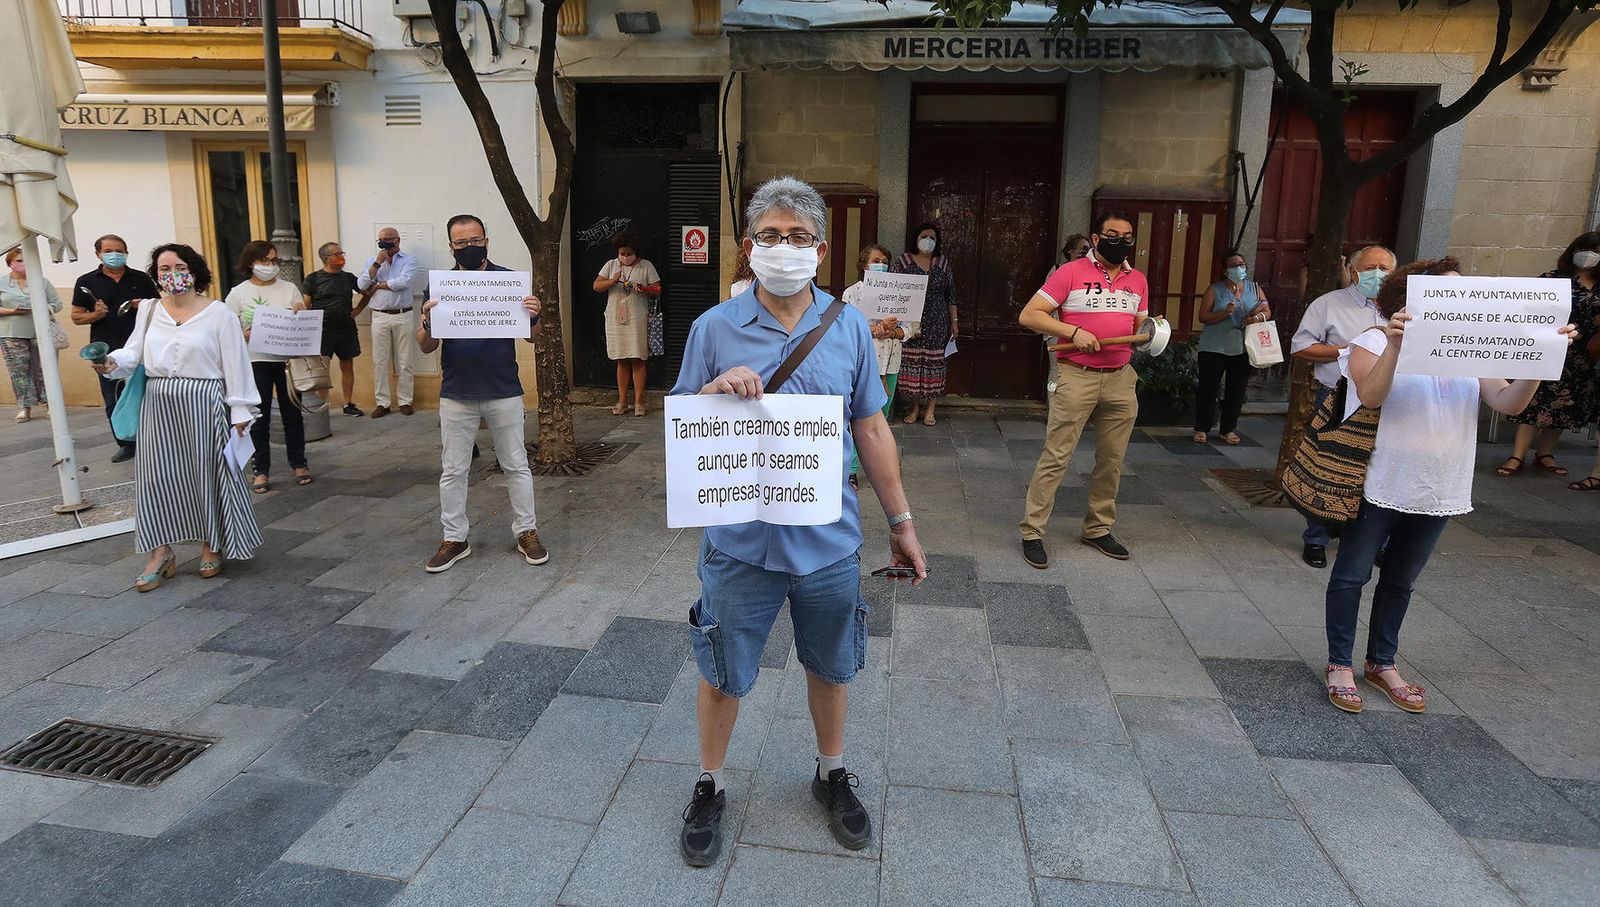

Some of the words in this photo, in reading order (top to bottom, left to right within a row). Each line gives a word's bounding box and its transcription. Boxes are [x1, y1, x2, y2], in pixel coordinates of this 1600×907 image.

[884, 38, 1031, 58] MERCERIA
[1040, 38, 1141, 58] TRIBER
[60, 107, 129, 125] CRUZ
[143, 107, 245, 125] BLANCA
[874, 279, 887, 288] Junta
[1084, 282, 1102, 294] 73
[1106, 298, 1117, 307] 52
[1423, 290, 1456, 298] JUNTA
[1469, 291, 1560, 302] AYUNTAMIENTO,
[1424, 310, 1483, 322] PÓNGANSE
[1487, 314, 1500, 322] DE
[1504, 314, 1555, 324] ACUERDO
[1440, 334, 1474, 344] ESTÁIS
[1478, 337, 1534, 347] MATANDO
[1446, 349, 1490, 359] CENTRO
[1494, 351, 1507, 359] DE
[1511, 351, 1542, 360] JEREZ
[672, 416, 729, 439] También
[734, 418, 789, 436] creamos
[794, 417, 840, 442] empleo,
[698, 453, 747, 474] aunque
[752, 452, 765, 467] no
[770, 453, 819, 469] seamos
[698, 483, 760, 507] empresas
[764, 483, 818, 505] grandes.
